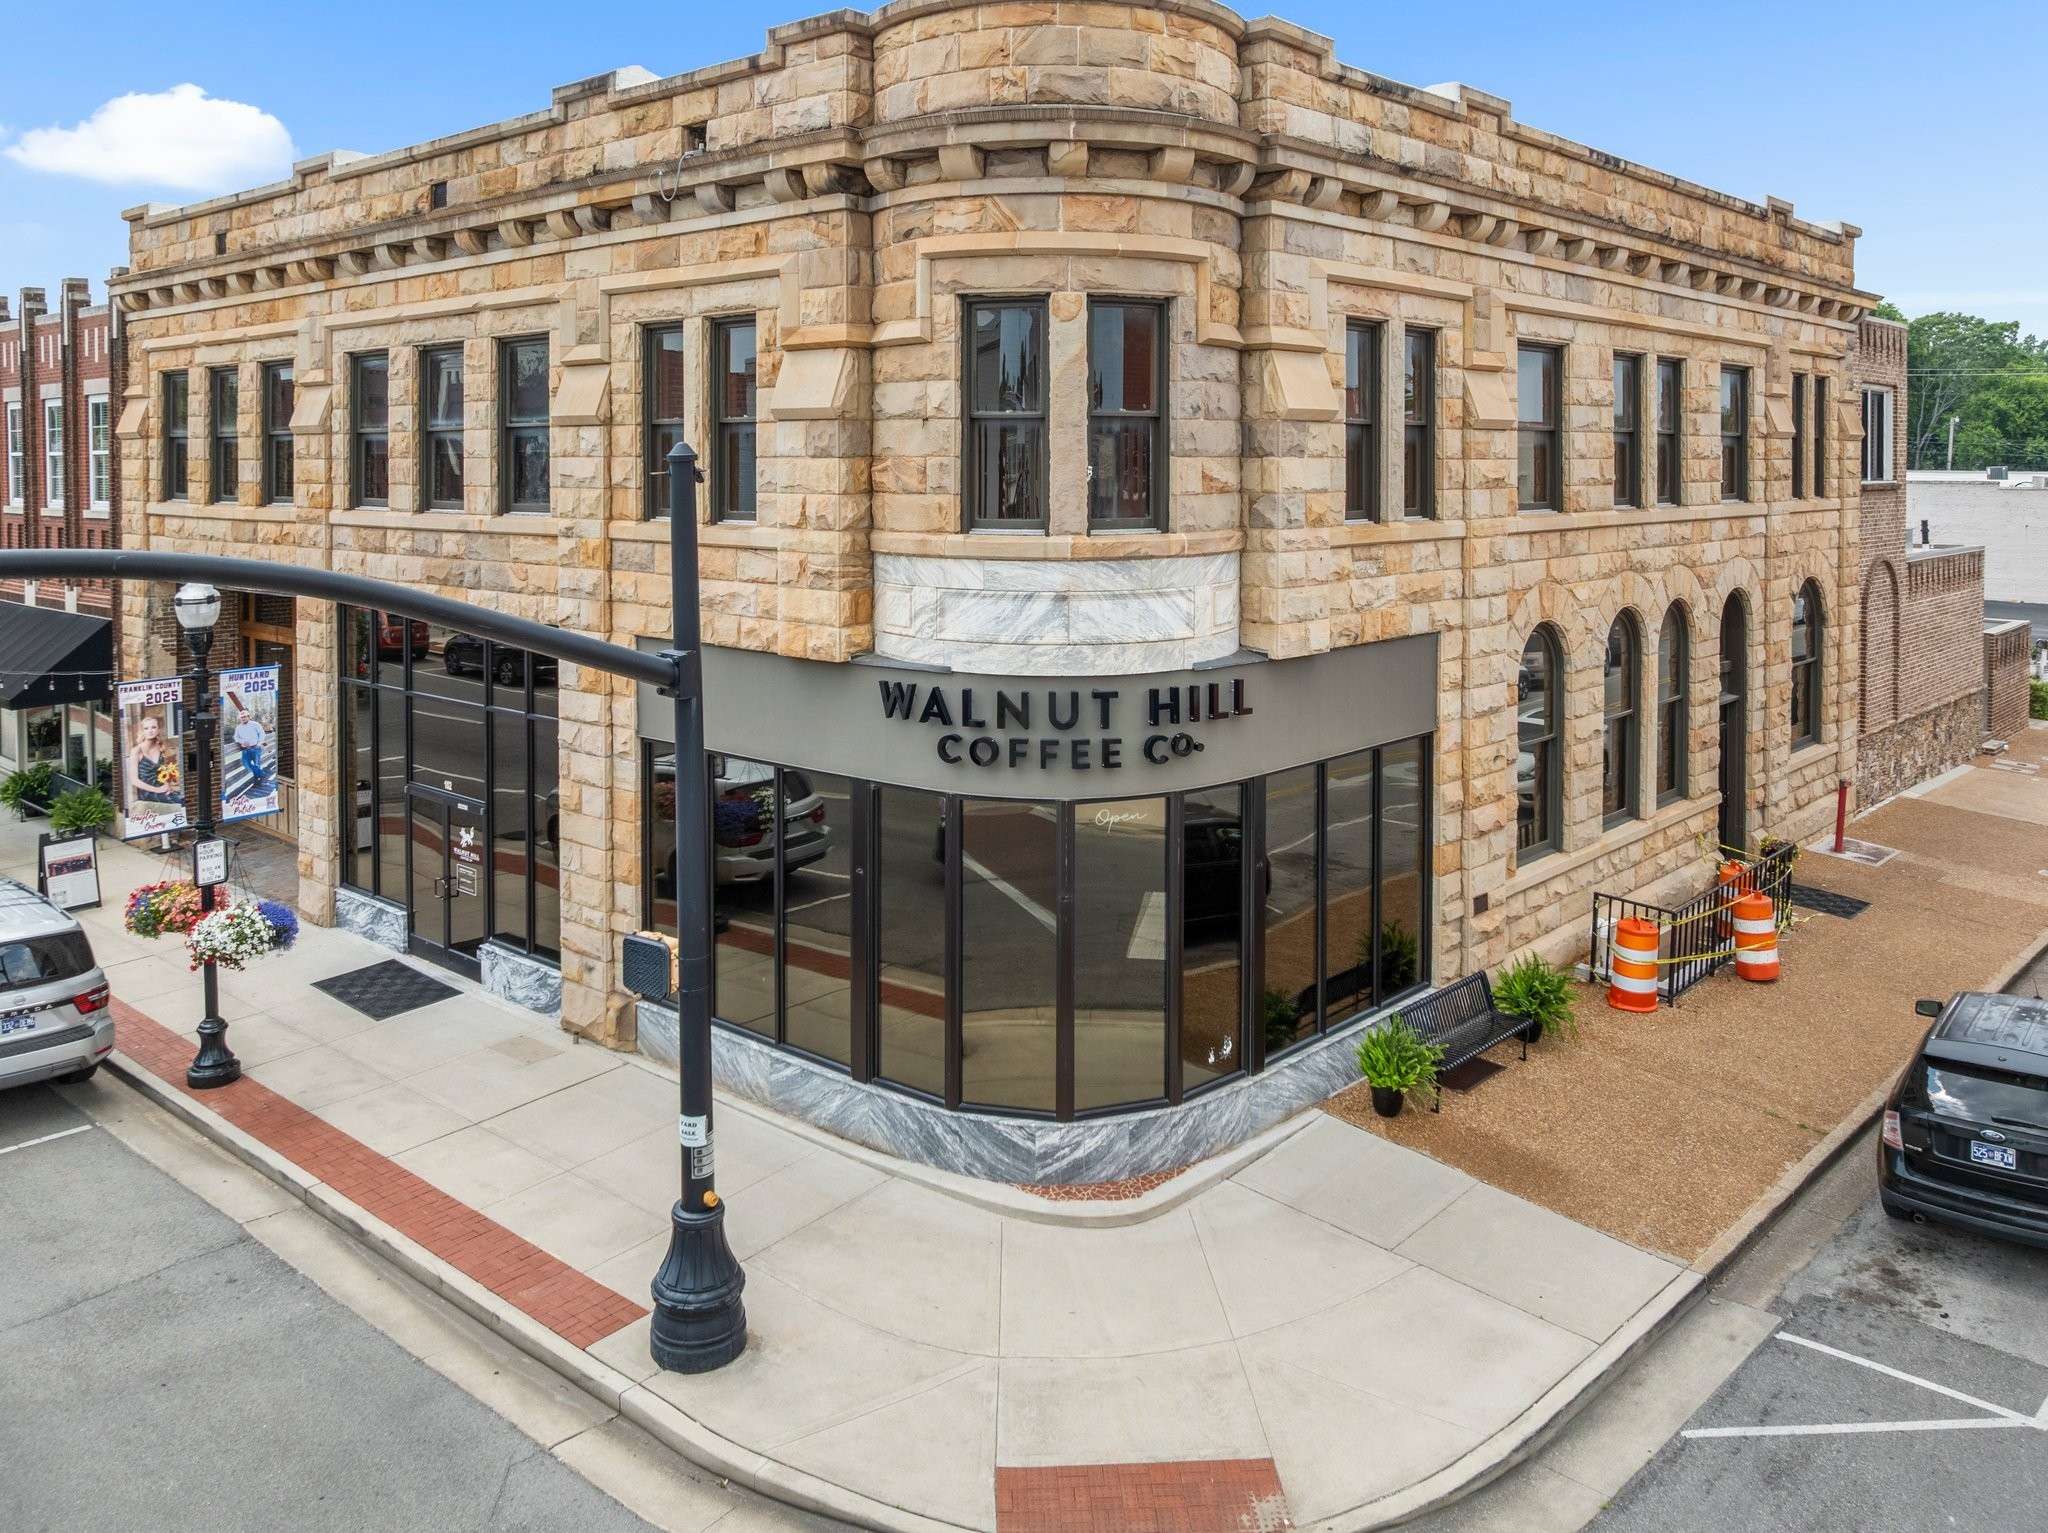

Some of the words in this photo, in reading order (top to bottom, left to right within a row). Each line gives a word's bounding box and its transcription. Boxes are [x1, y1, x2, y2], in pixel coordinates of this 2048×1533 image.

[229, 671, 269, 681] HUNTLAND
[120, 685, 153, 693] FRANKLIN
[155, 682, 181, 690] COUNTY
[244, 679, 275, 693] 2025
[146, 690, 179, 705] 2025
[879, 680, 1119, 731] WALNUT
[1148, 679, 1253, 727] HILL
[937, 733, 1123, 770] COFFEE
[1095, 809, 1148, 834] Open
[200, 852, 223, 860] PARKING
[1973, 1147, 1988, 1159] 525
